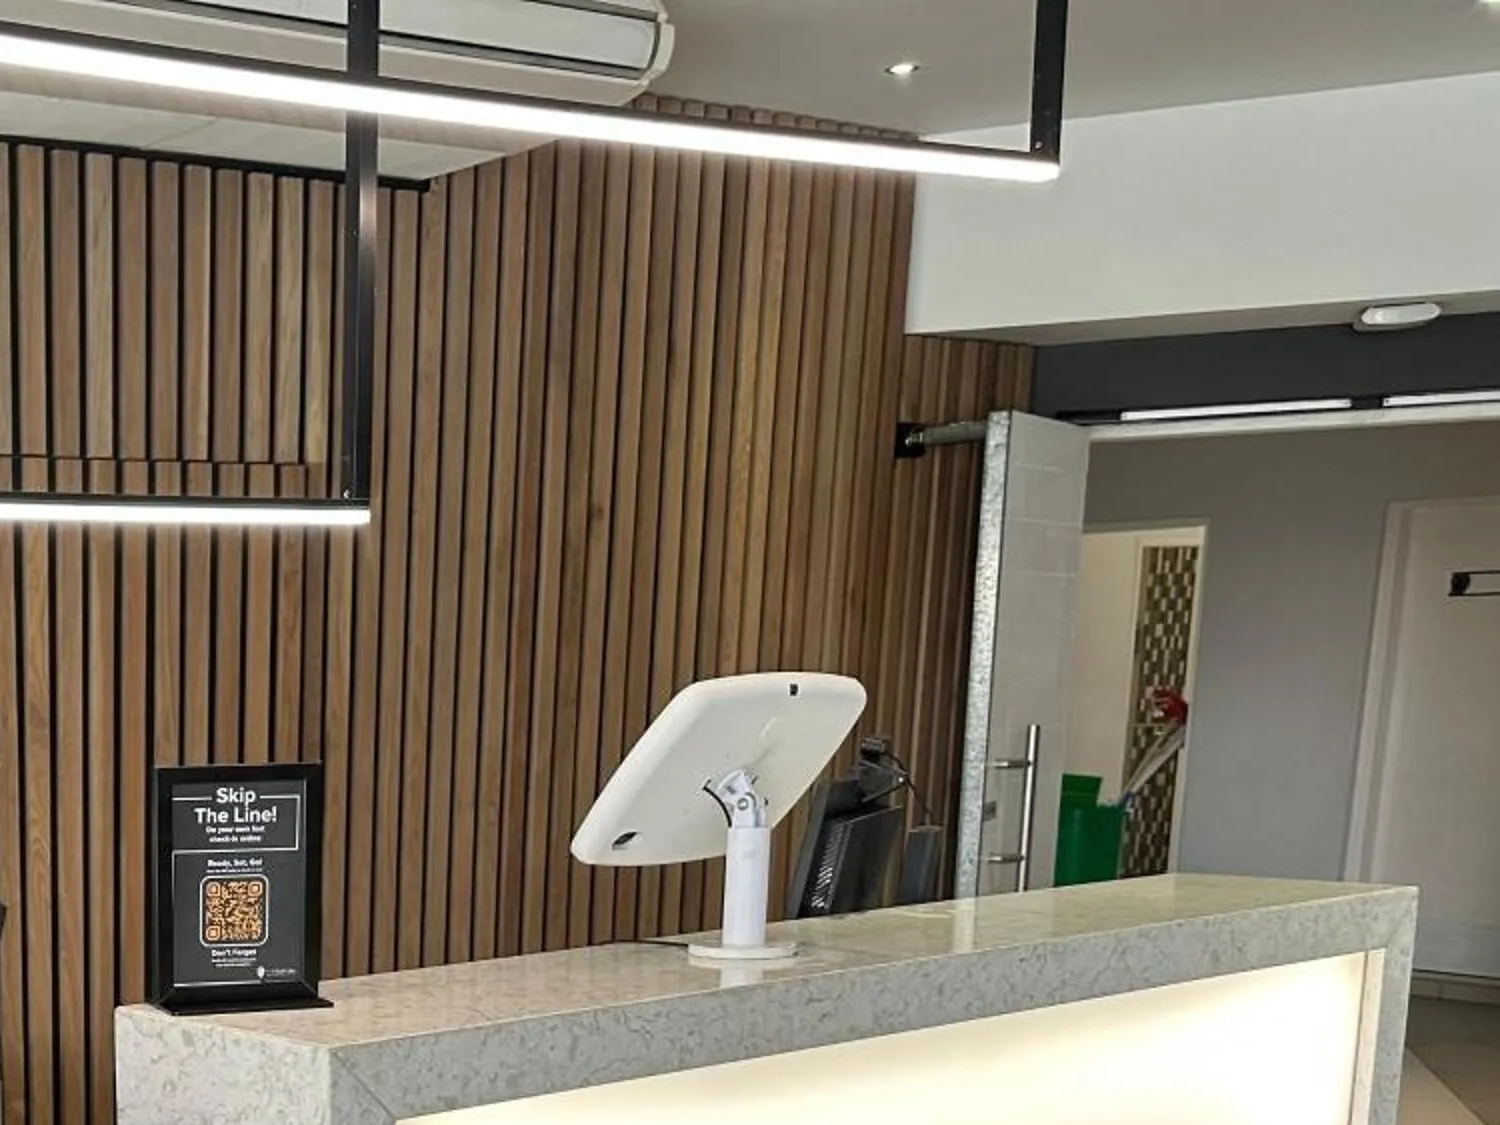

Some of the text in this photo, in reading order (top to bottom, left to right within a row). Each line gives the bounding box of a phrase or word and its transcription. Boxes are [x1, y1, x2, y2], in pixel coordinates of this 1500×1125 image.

[216, 787, 256, 806] Skip
[194, 806, 277, 824] The Line!
